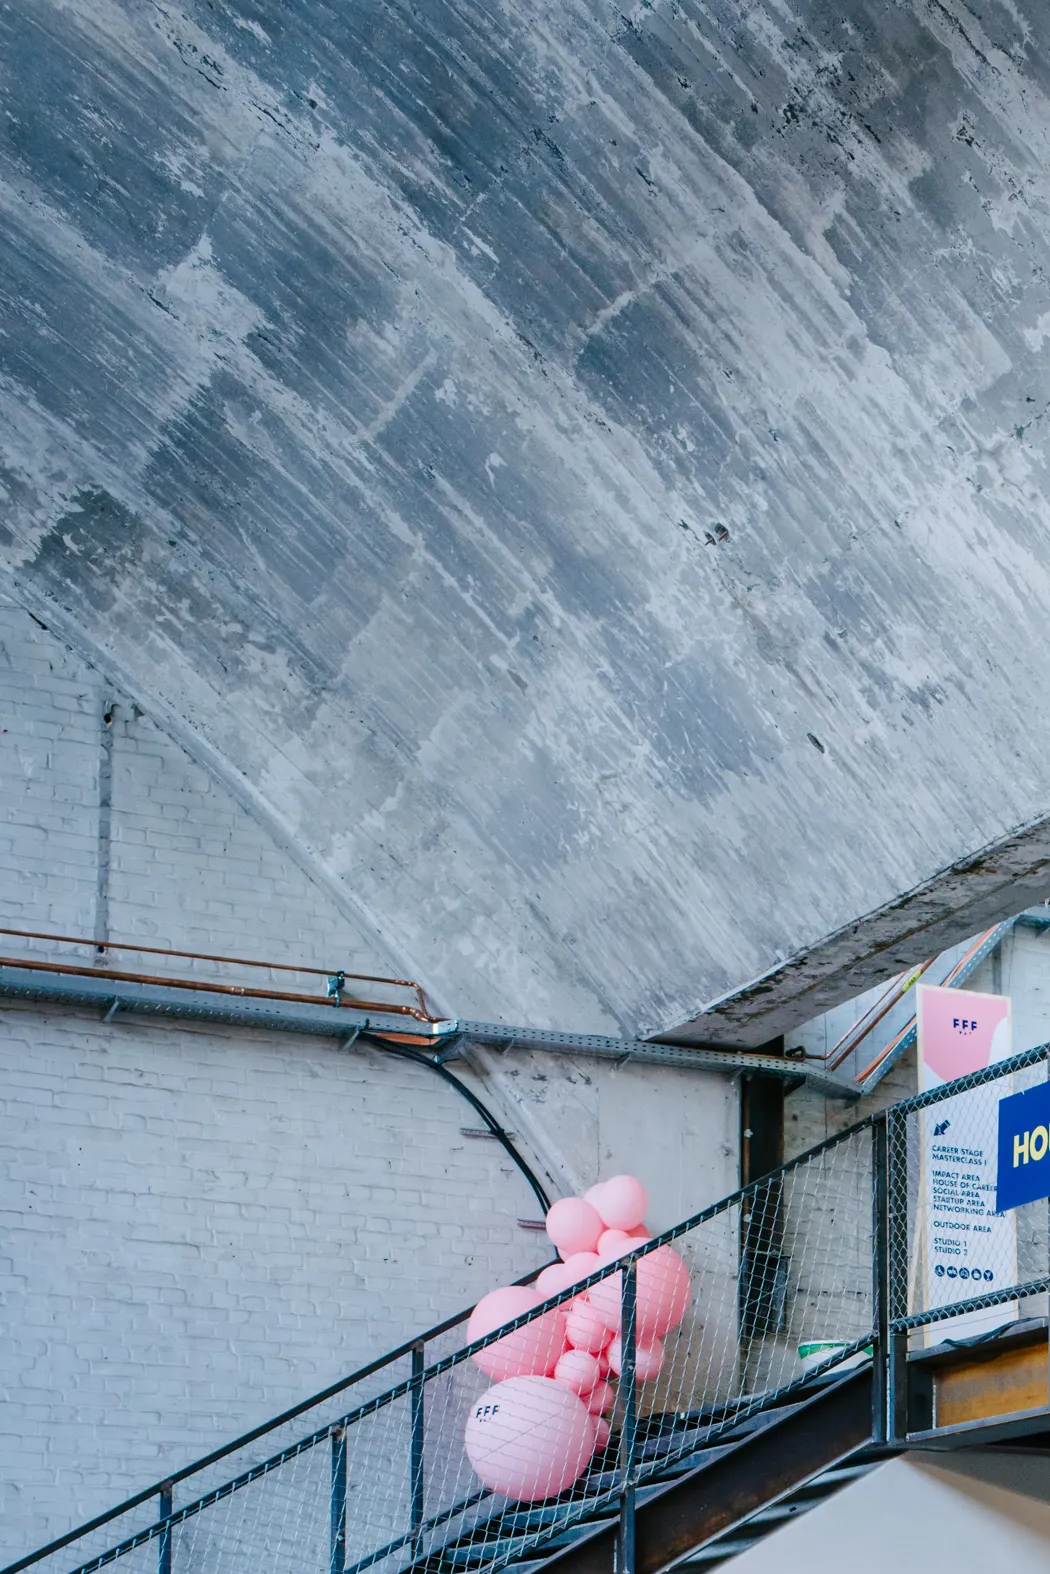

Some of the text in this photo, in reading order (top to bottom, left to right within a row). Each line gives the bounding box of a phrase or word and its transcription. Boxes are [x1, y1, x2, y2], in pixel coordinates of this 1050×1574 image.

[932, 1145, 984, 1157] CAREER STAGE
[932, 1153, 983, 1166] MASTERCLASS
[932, 1170, 981, 1182] IMPACT AREA
[932, 1178, 958, 1188] HOUSE
[960, 1181, 970, 1189] OF
[933, 1187, 980, 1198] SOCIAL AREA
[933, 1195, 985, 1207] STARTUP AREA
[933, 1204, 1006, 1218] NETWORKING AREA
[933, 1220, 992, 1233] OUTDOOR AREA
[934, 1237, 961, 1247] STUDIO
[934, 1246, 968, 1256] STUDIO 2
